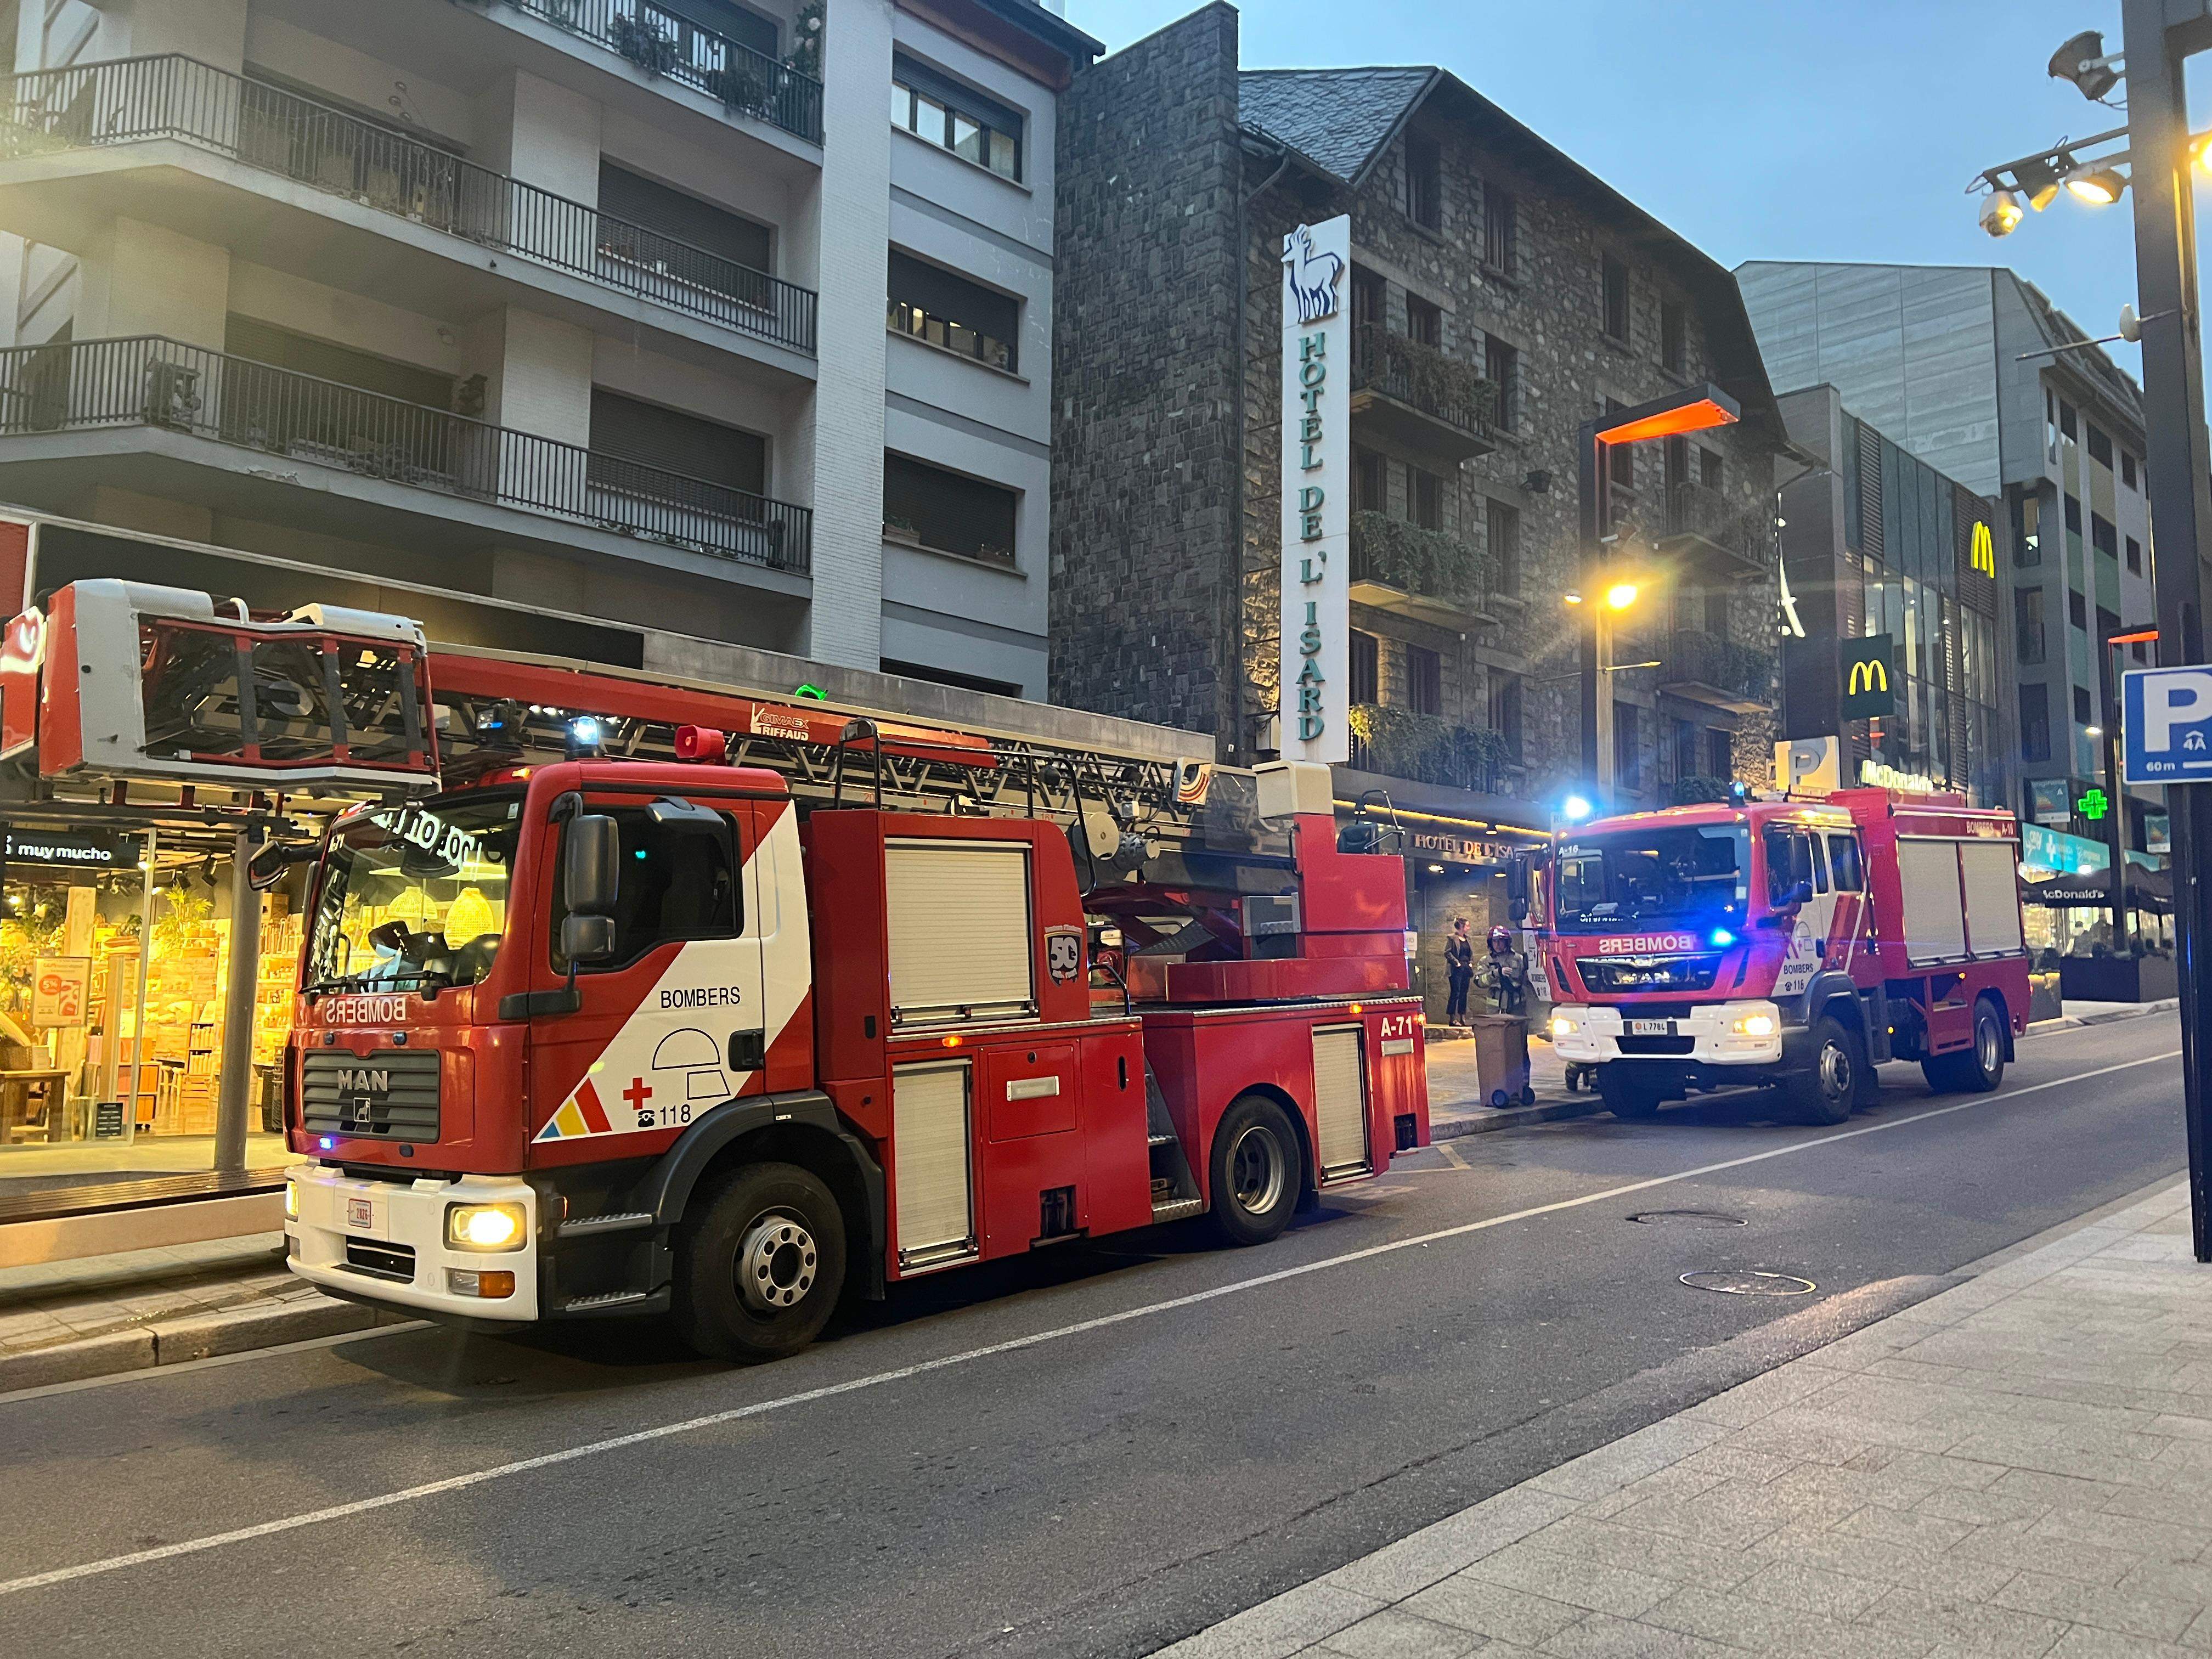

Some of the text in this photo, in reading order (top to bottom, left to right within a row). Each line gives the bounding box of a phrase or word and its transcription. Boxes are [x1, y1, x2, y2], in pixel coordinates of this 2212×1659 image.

[1295, 332, 1327, 741] HOTEL DE L' ISARD
[2144, 673, 2212, 752] P
[763, 726, 809, 741] RIFFAUD
[1788, 746, 1820, 786] P
[19, 845, 112, 861] muy mucho
[1415, 834, 1460, 853] HOTEL
[1463, 840, 1481, 856] DE
[1784, 963, 1814, 974] BOMBERS
[661, 986, 741, 1008] BOMBERS
[1381, 1016, 1412, 1037] A-71
[337, 1070, 388, 1091] MAN
[659, 1104, 691, 1125] 118
